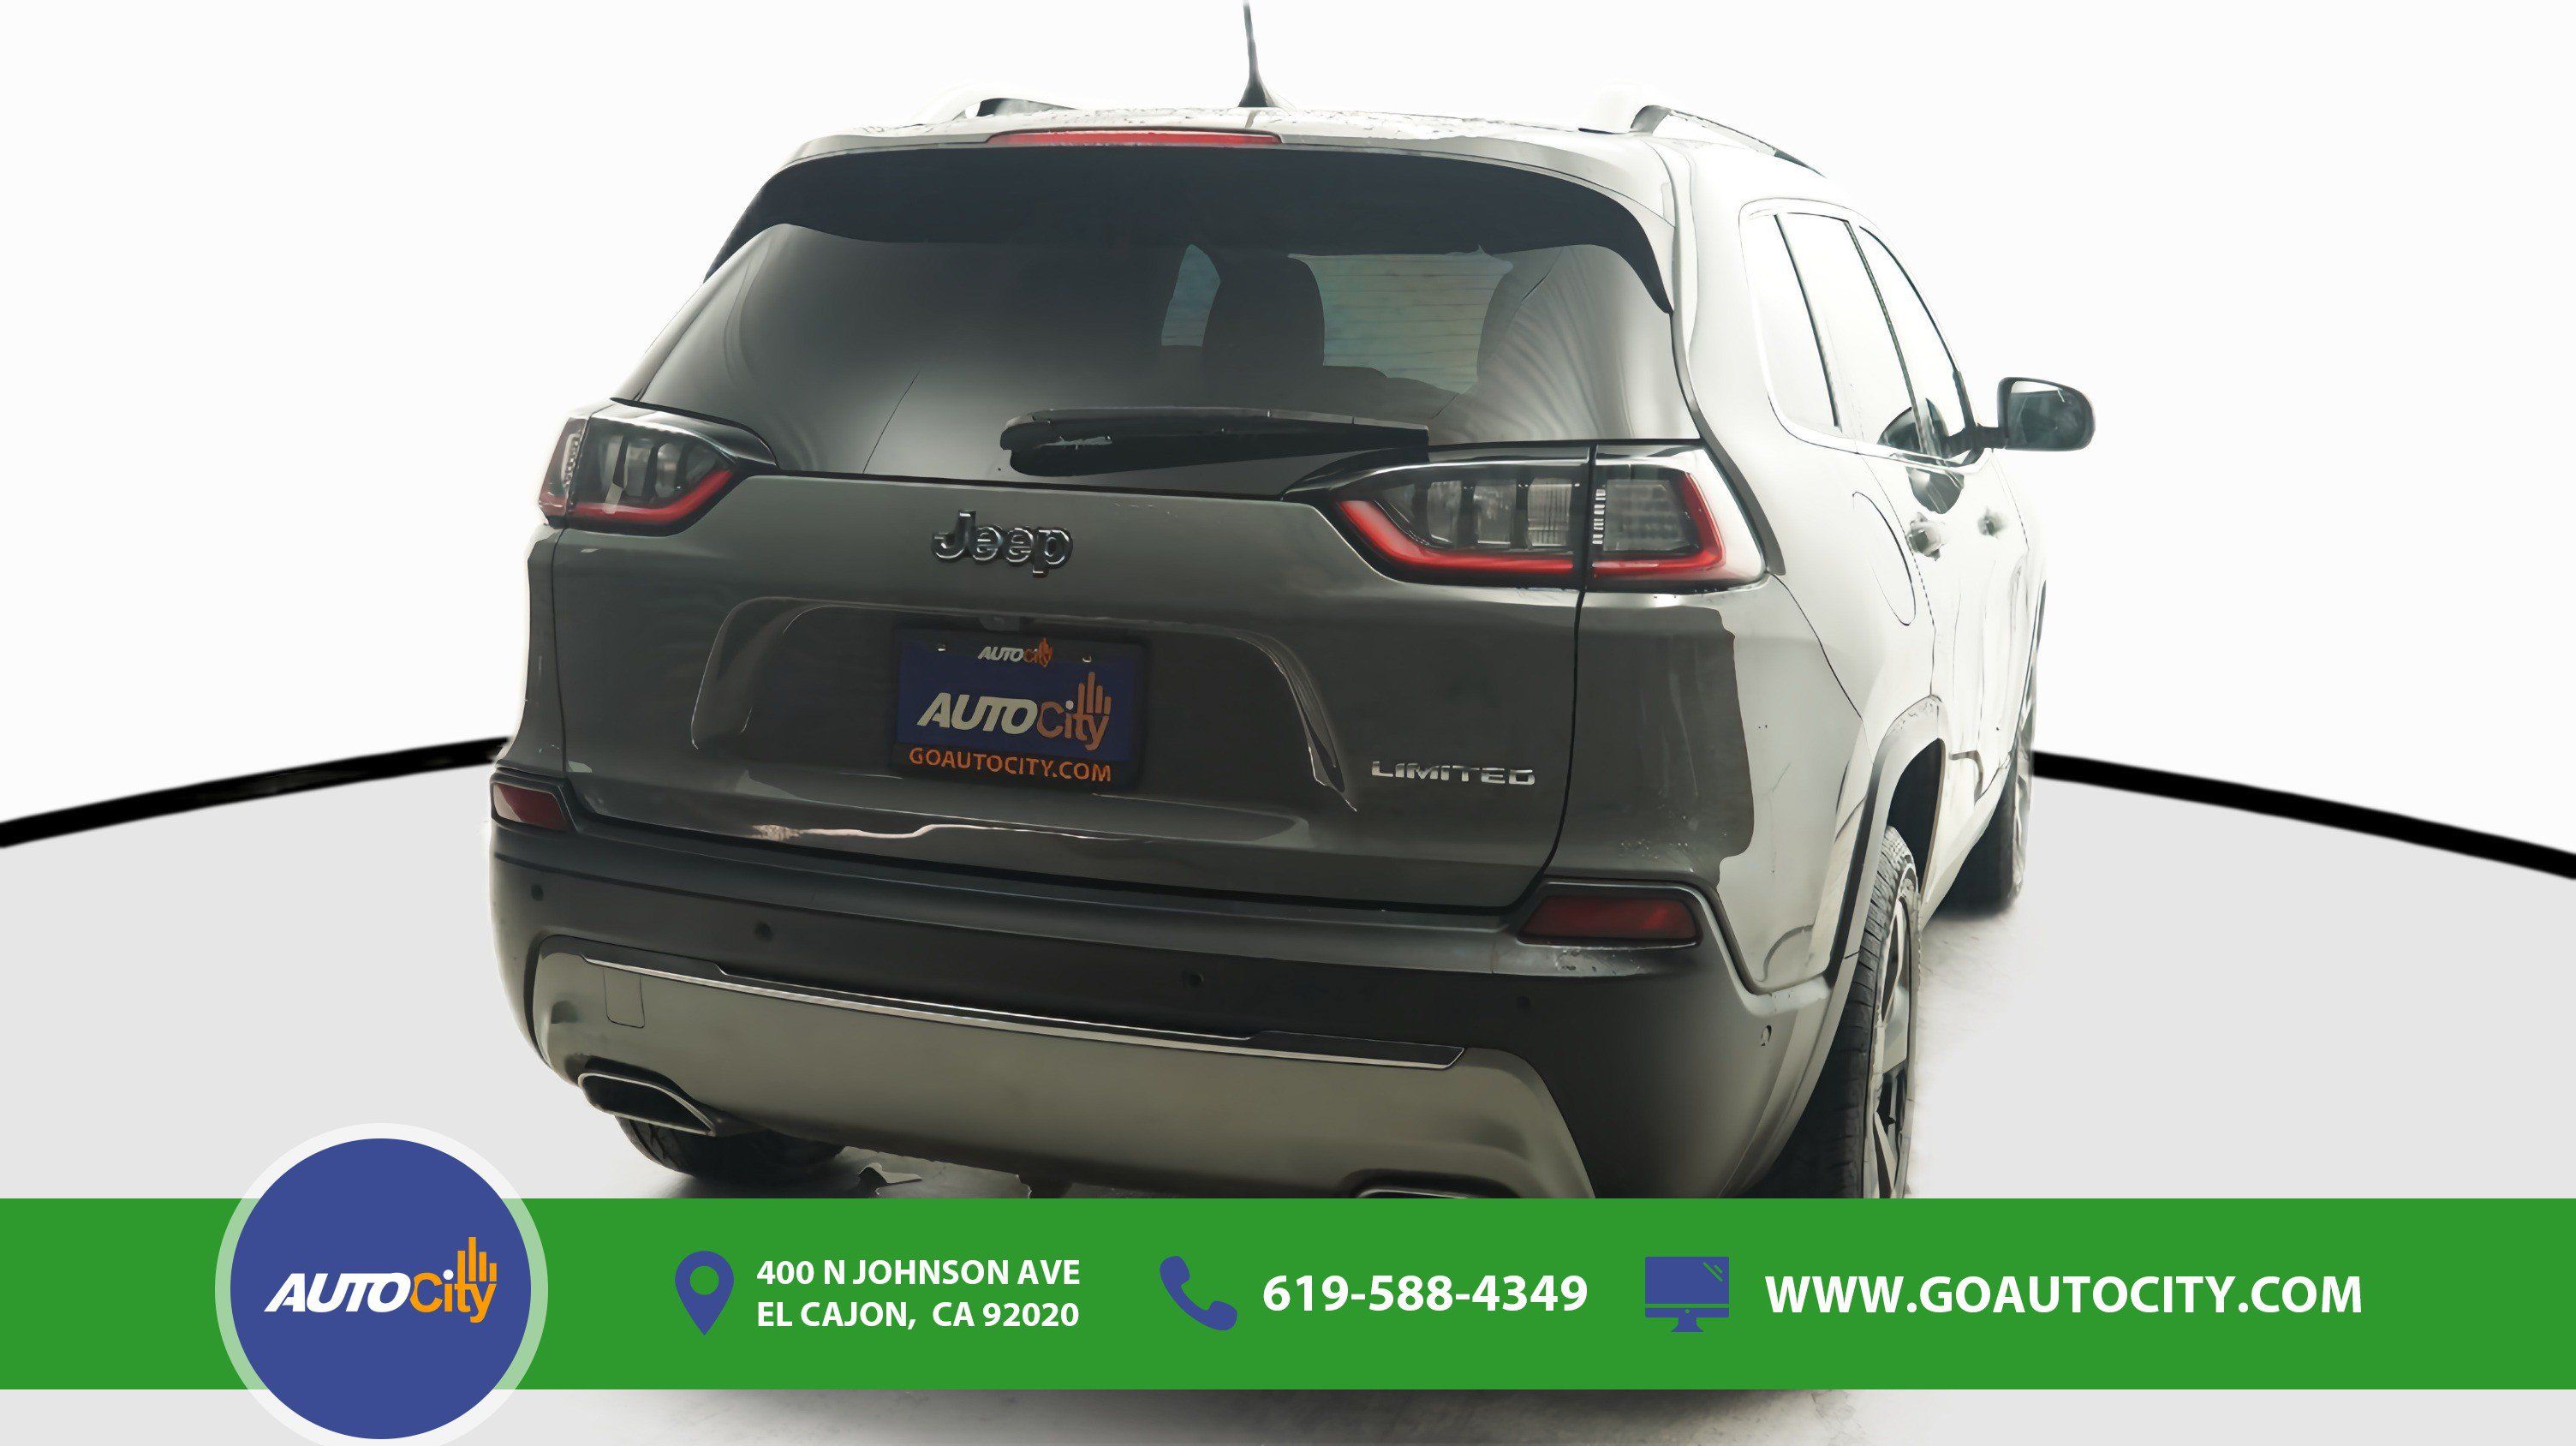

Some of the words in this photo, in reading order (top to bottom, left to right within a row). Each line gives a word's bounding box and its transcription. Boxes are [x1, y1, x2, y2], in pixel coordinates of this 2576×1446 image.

[931, 510, 1072, 577] Jeep
[908, 747, 1112, 782] GOAUTOCITY.COM
[1371, 761, 1535, 786] LIMITED
